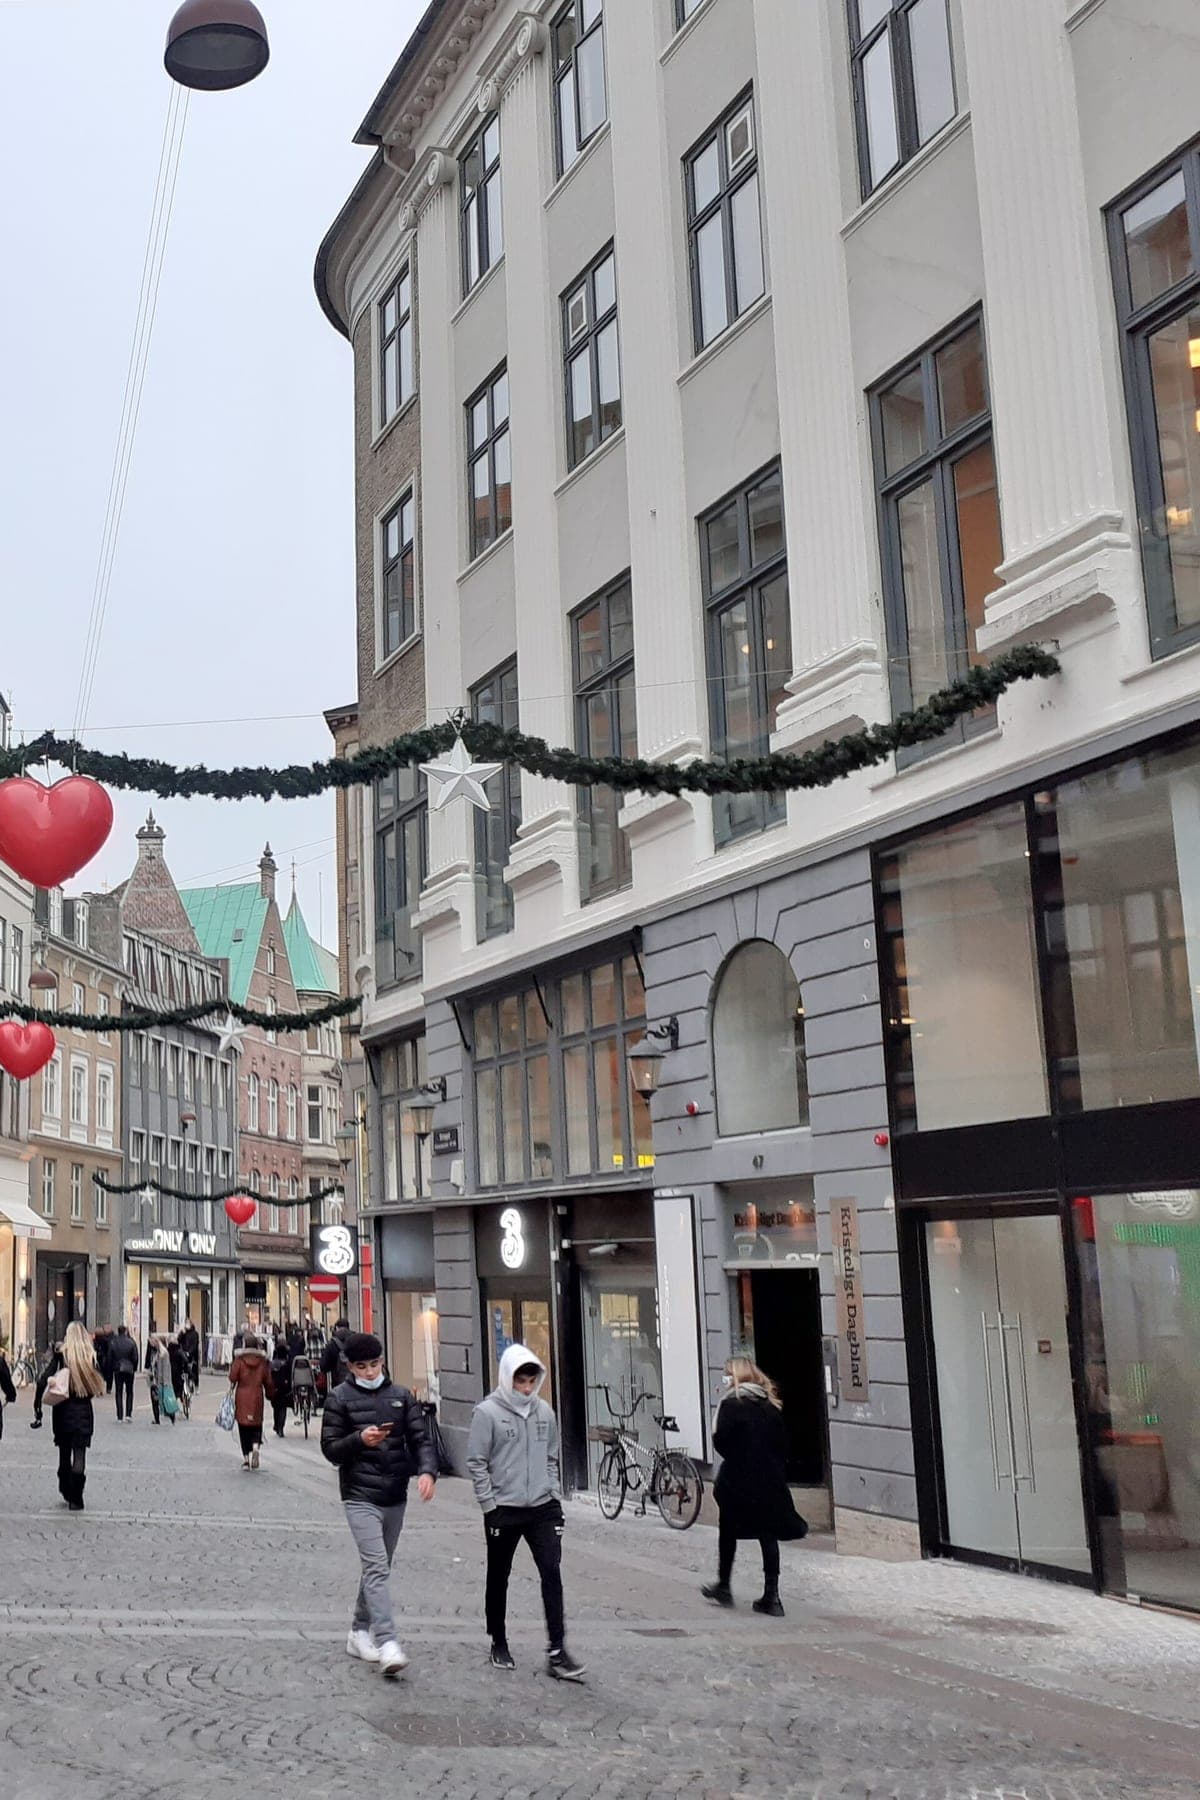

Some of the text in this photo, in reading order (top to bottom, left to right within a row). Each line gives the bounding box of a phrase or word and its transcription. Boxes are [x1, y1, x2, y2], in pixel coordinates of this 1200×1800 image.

[132, 1229, 216, 1255] ONLY ONLY ONLY
[840, 1207, 863, 1388] Kristeligt Dagblad
